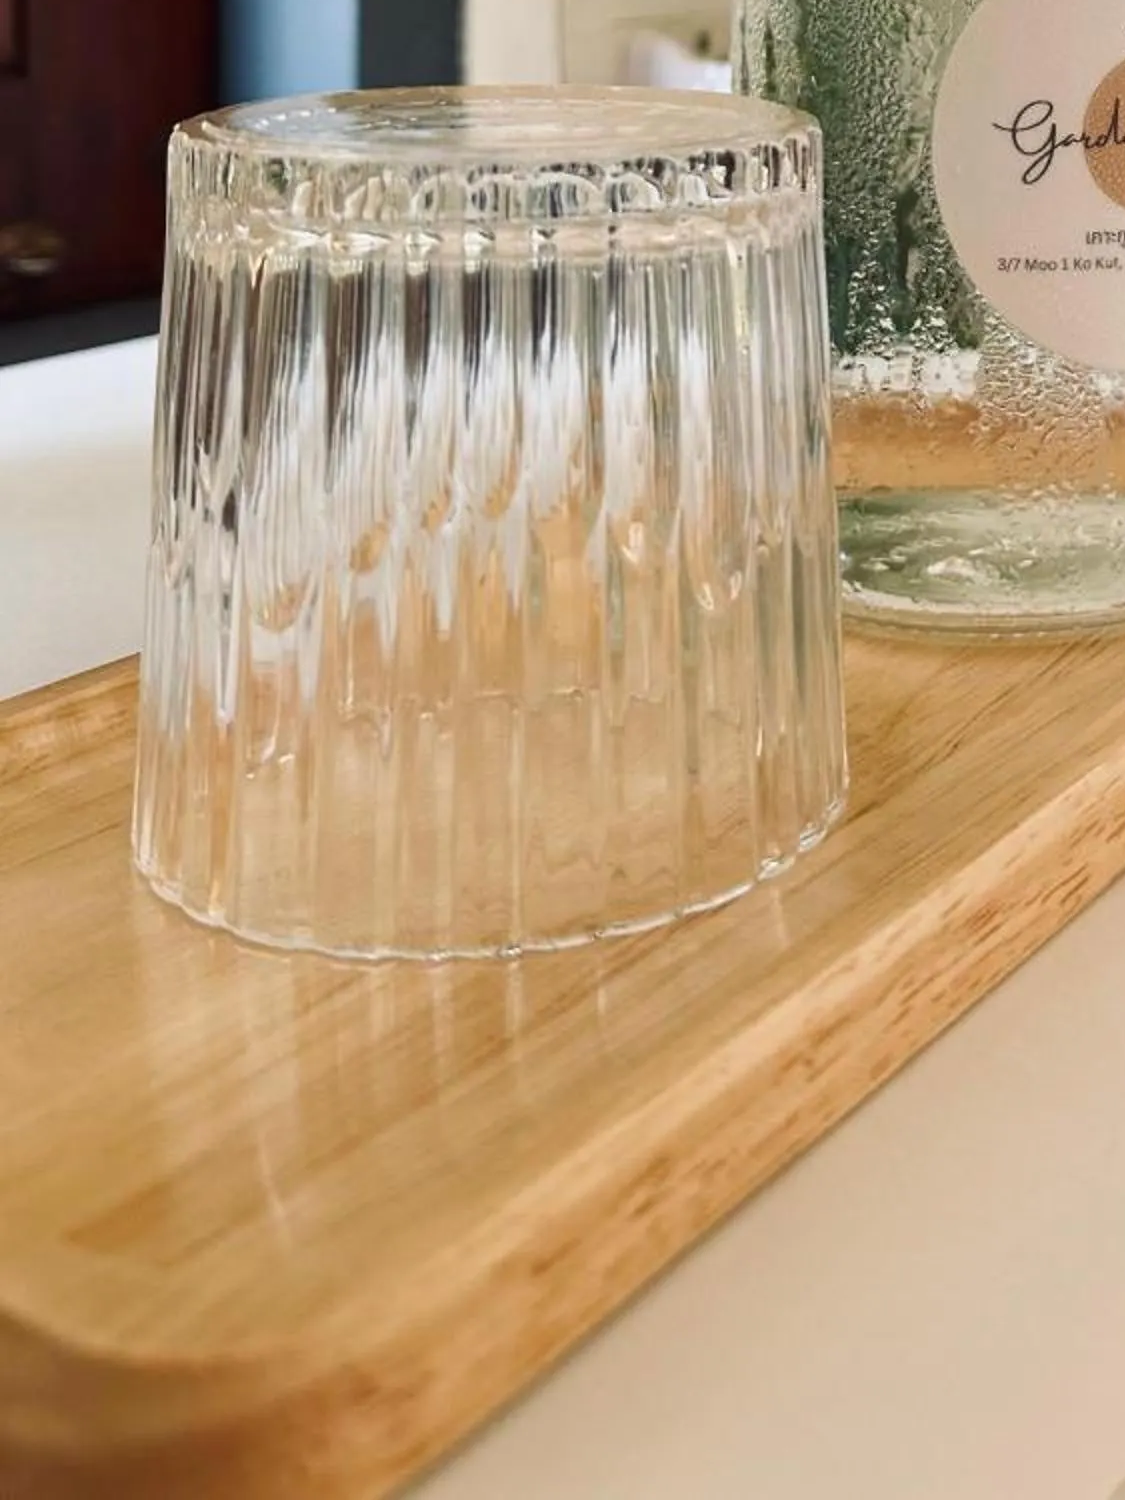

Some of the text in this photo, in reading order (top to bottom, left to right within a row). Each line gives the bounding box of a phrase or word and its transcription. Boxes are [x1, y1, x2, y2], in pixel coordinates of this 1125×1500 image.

[997, 257, 1021, 272] 3/7
[1025, 258, 1057, 272] Moo
[1061, 258, 1069, 271] 1
[1073, 257, 1091, 271] Ko
